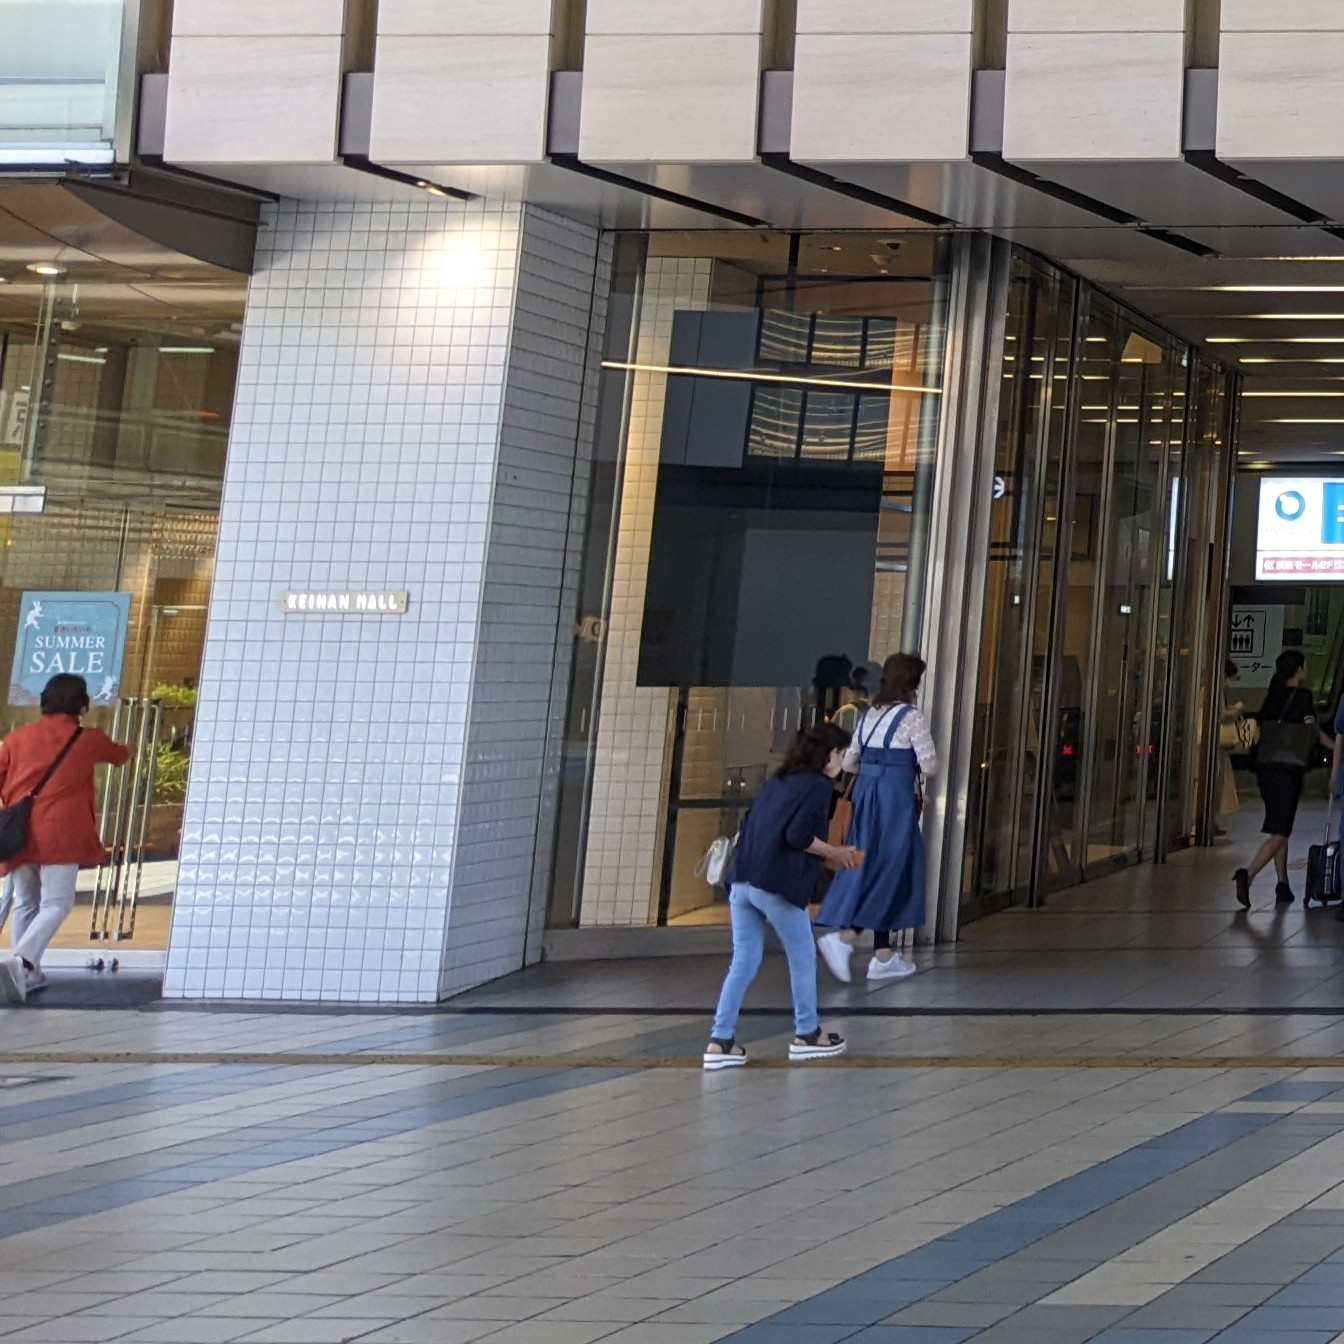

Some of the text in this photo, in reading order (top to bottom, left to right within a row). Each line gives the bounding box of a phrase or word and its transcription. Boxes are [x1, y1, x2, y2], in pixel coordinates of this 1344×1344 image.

[288, 594, 350, 609] KEIHAN
[35, 635, 106, 649] SUMMER
[30, 651, 104, 673] SALE
